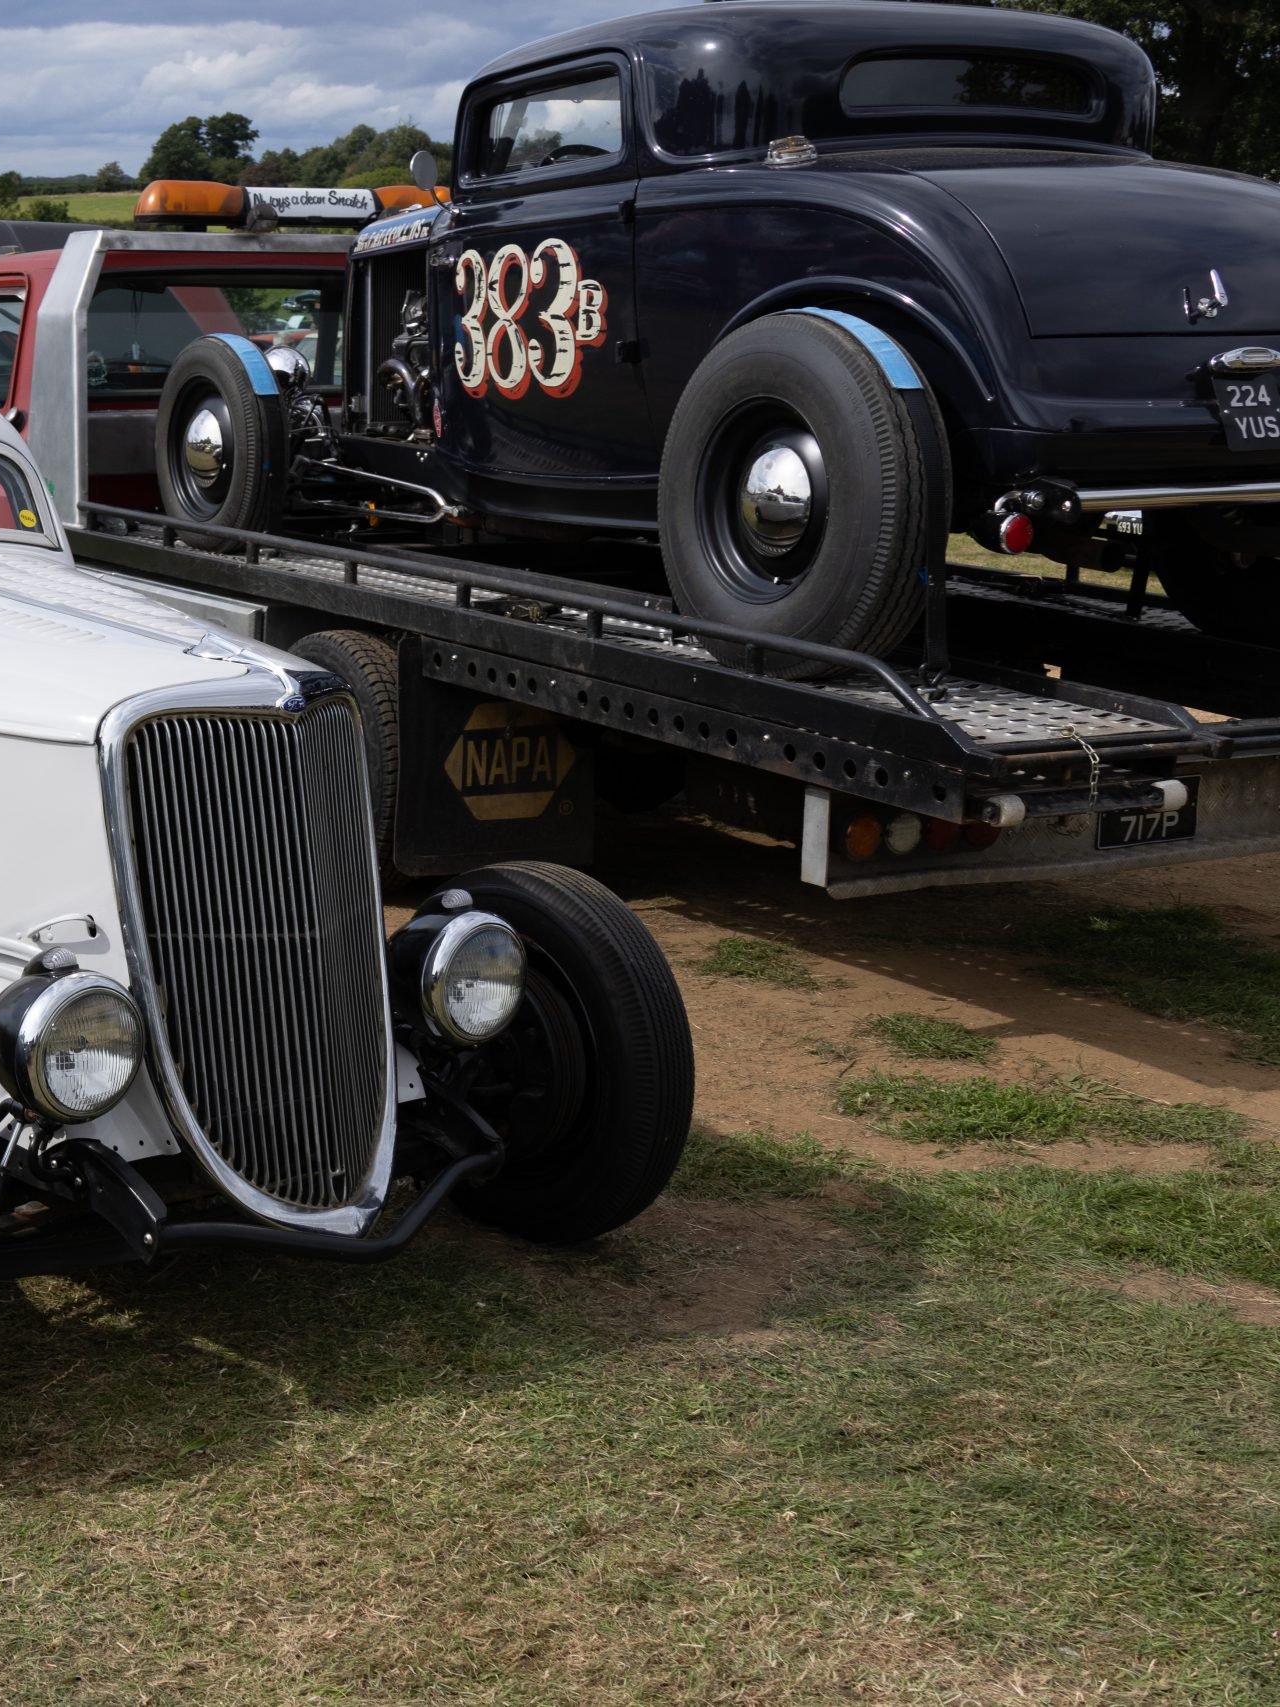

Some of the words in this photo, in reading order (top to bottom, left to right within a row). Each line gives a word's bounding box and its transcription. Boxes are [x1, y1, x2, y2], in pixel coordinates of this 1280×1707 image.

[291, 196, 299, 205] a
[328, 190, 368, 210] Snatch
[455, 238, 581, 399] 383
[1226, 384, 1271, 407] 224
[1234, 416, 1280, 439] YUS
[466, 736, 552, 787] NAPA
[1120, 811, 1179, 842] 717P
